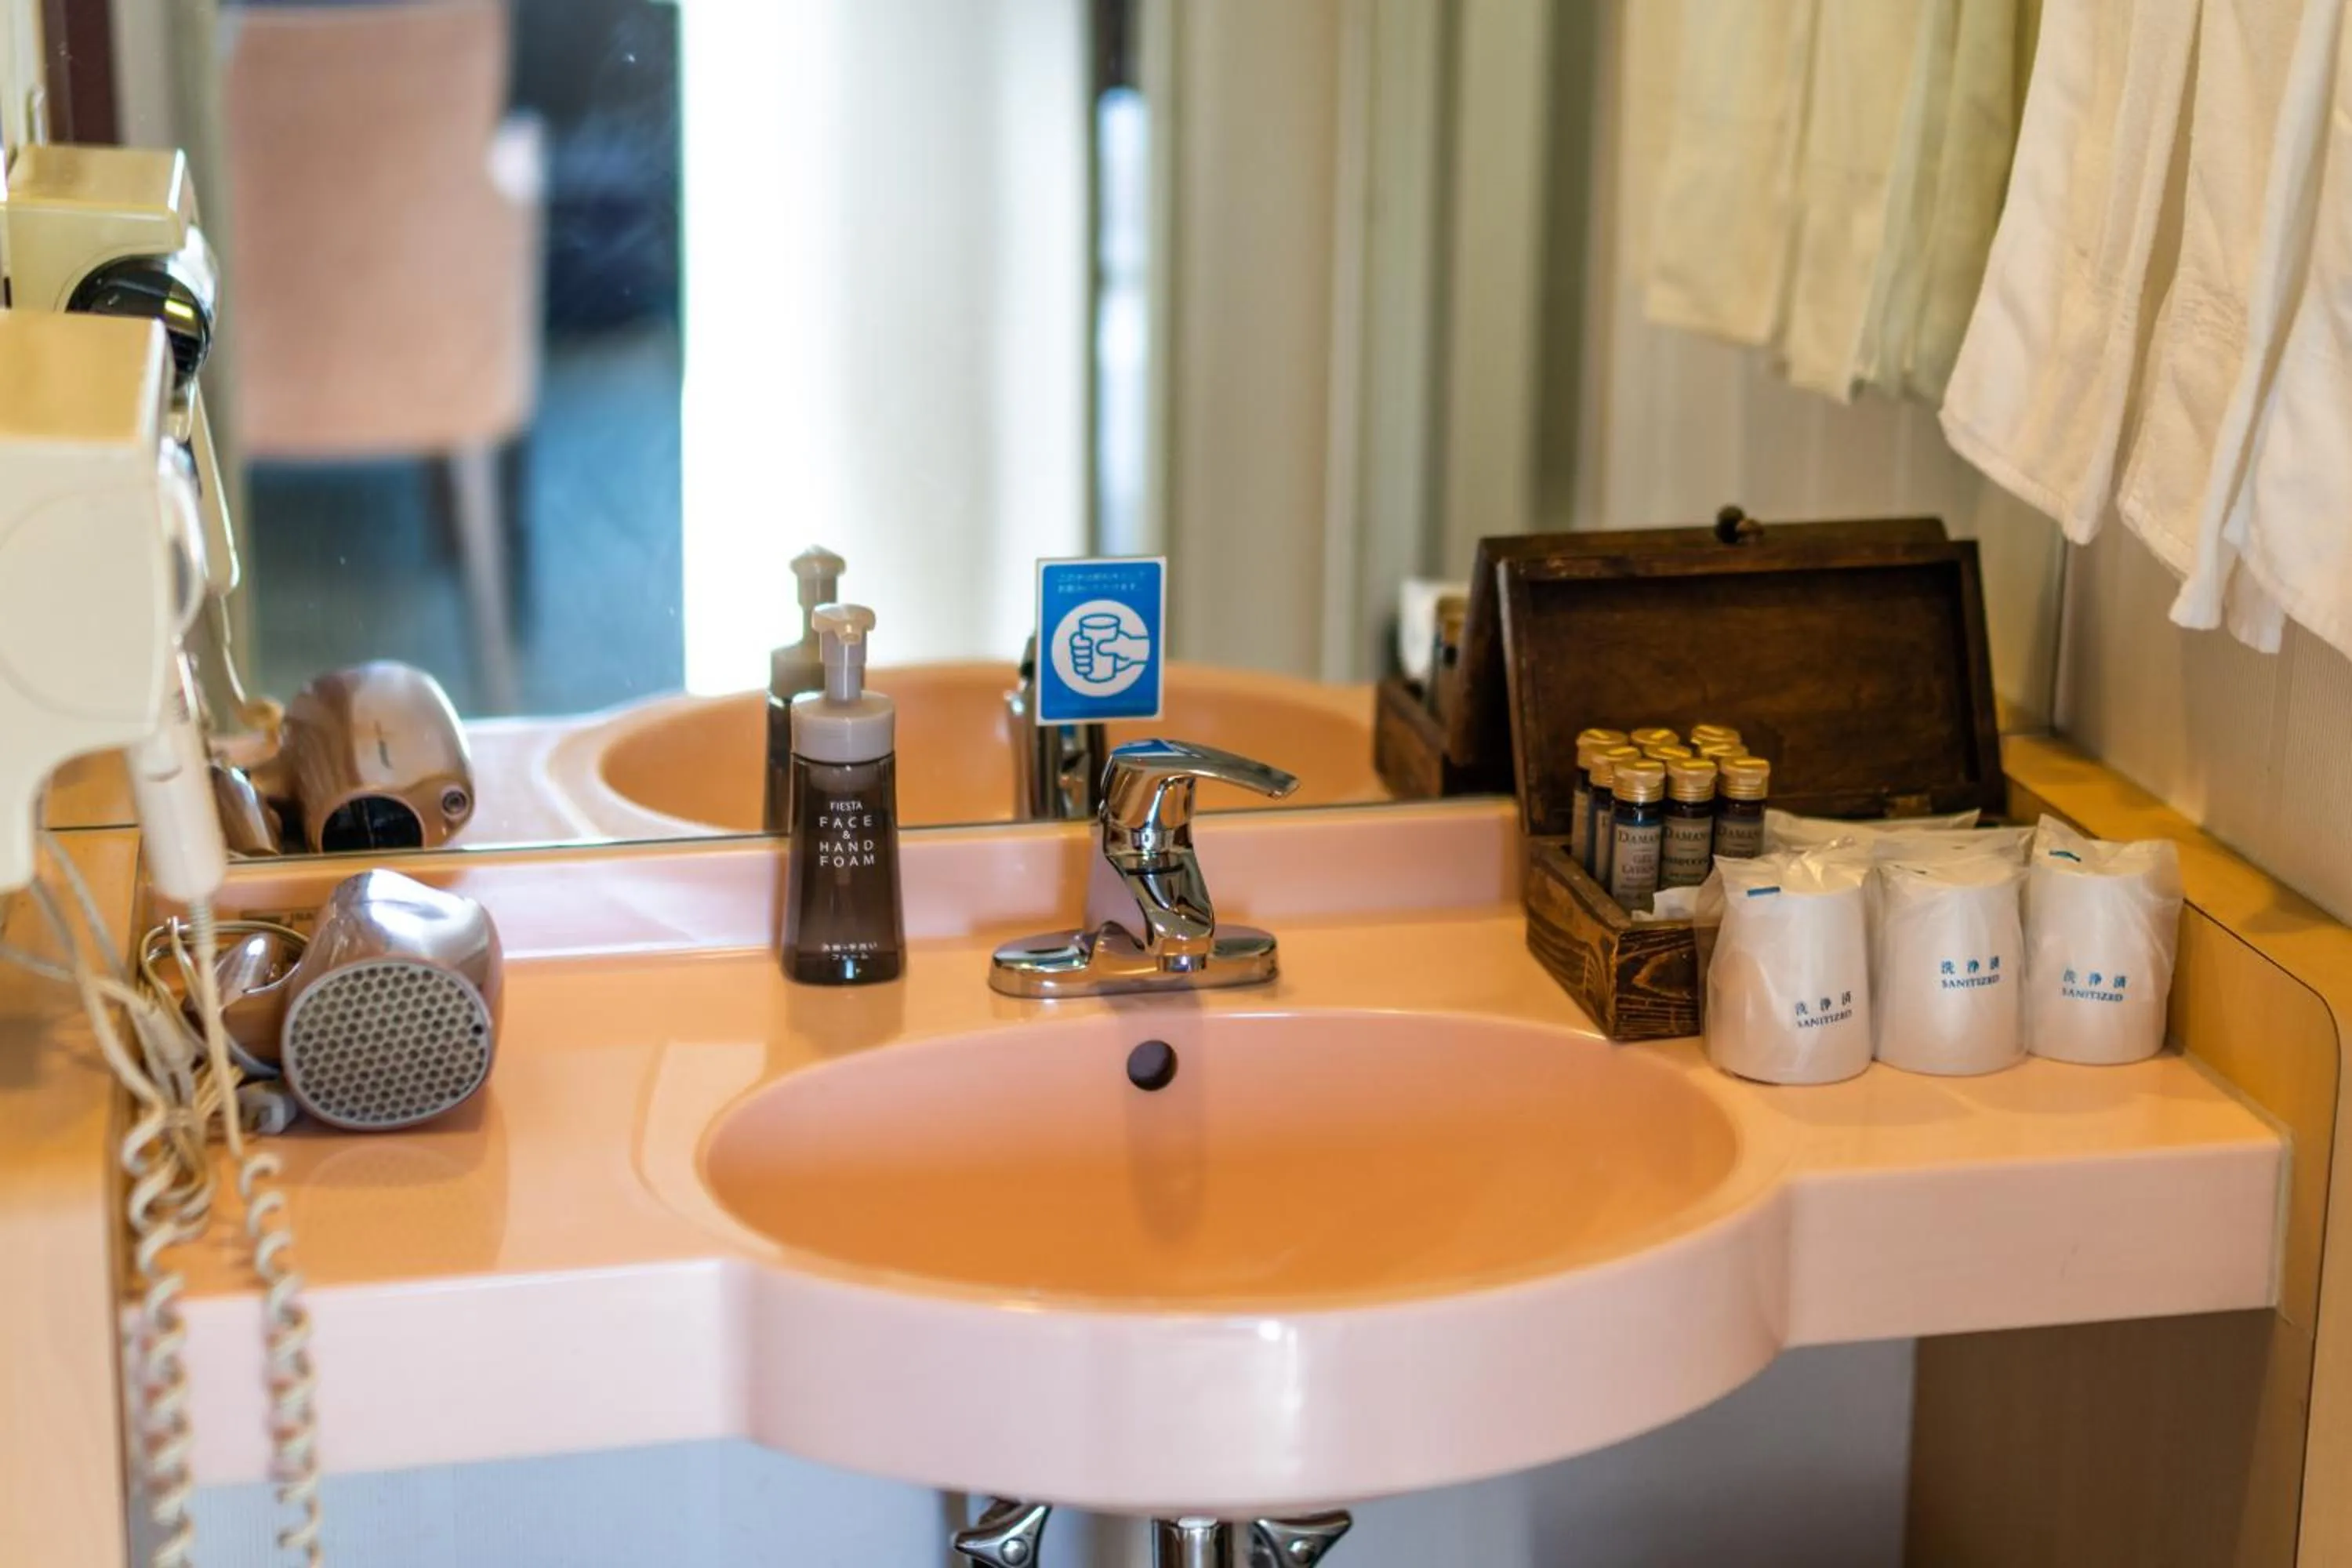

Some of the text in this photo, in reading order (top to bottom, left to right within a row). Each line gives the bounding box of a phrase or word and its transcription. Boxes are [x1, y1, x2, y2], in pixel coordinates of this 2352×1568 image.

[830, 801, 863, 811] FIESTA
[819, 815, 873, 829] FACE
[842, 830, 851, 840] &
[819, 840, 874, 853] HAND
[819, 855, 875, 868] FOAM
[2062, 987, 2124, 1002] SANITIZED
